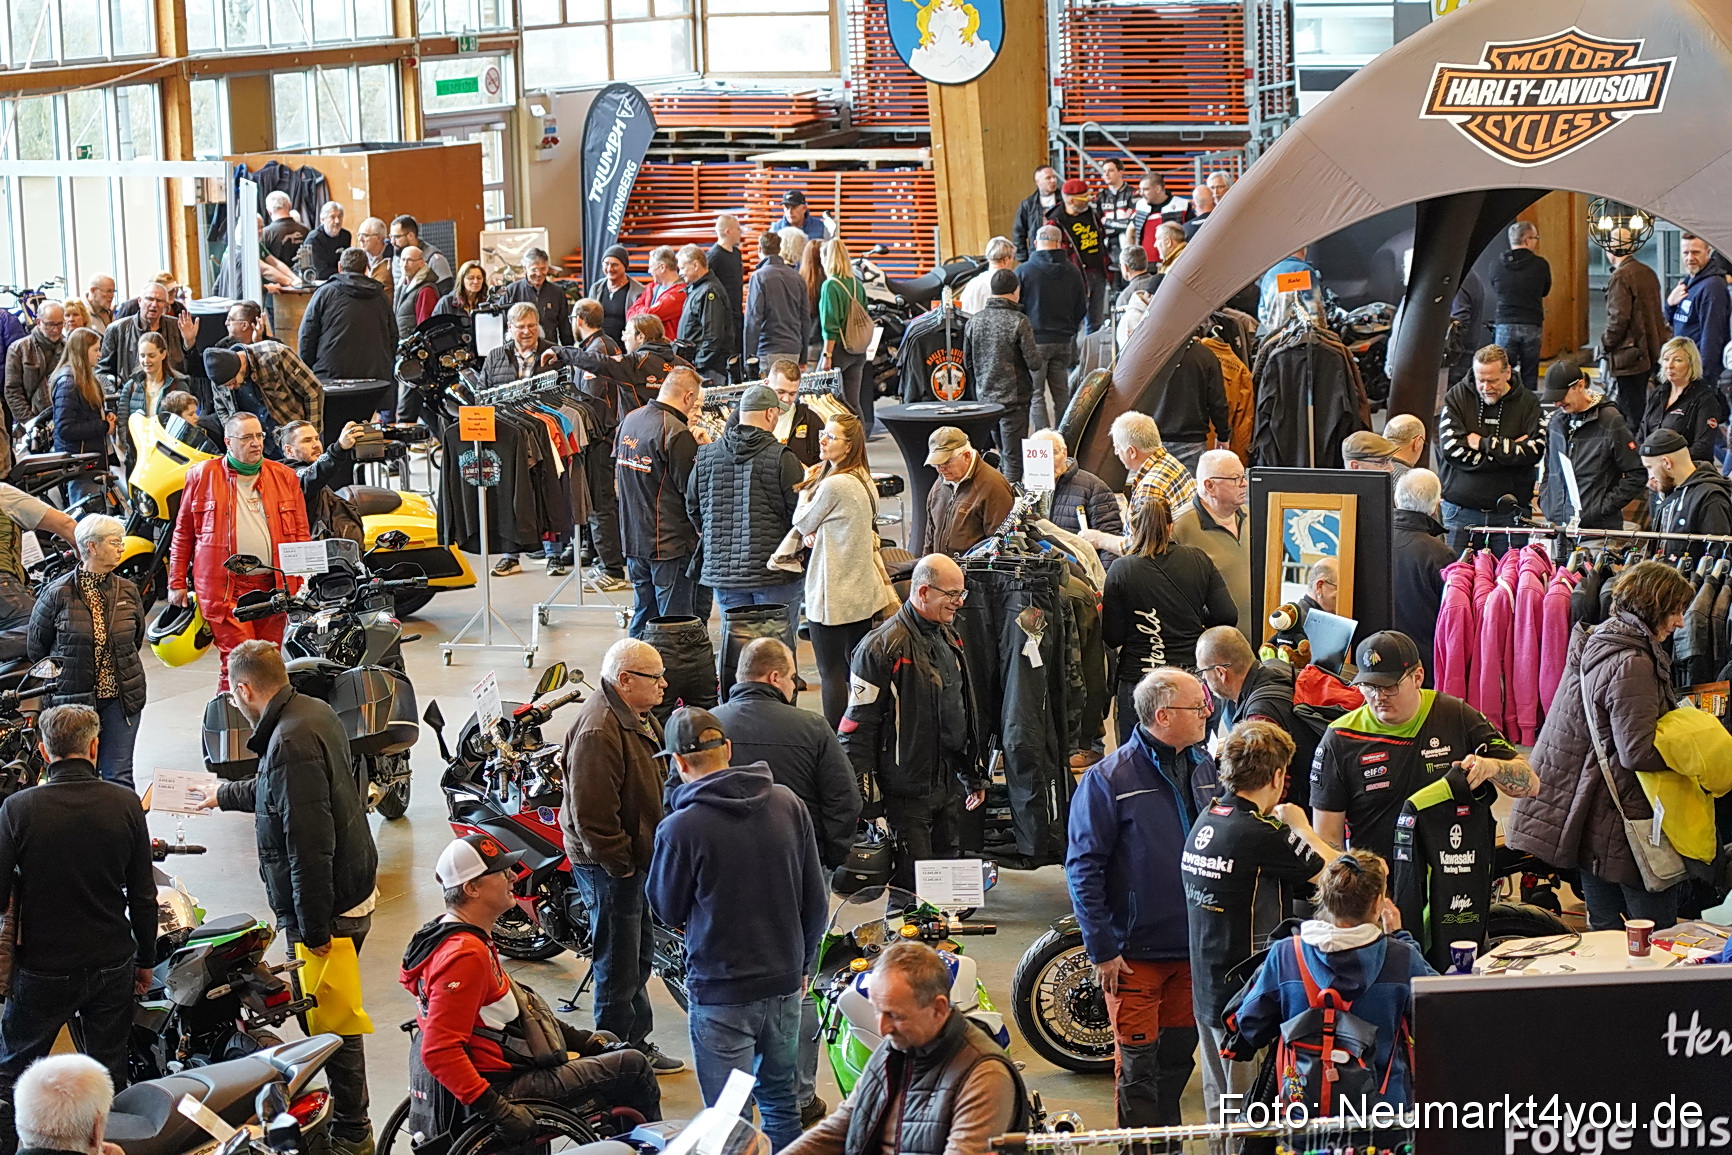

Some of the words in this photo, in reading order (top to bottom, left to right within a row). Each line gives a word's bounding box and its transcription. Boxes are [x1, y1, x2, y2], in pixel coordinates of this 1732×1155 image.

[1505, 42, 1615, 71] MOTOR
[1444, 73, 1653, 106] HARLEY-DAVIDSON
[1485, 114, 1592, 153] CYCLES
[588, 118, 627, 203] TRIUMPH
[606, 159, 637, 235] NÜRNBERG
[1287, 278, 1302, 288] Sale
[622, 435, 640, 450] Staff
[1027, 449, 1038, 459] 20
[1039, 449, 1049, 459] %
[1364, 767, 1378, 777] elf
[1183, 851, 1235, 874] awasaki
[1439, 850, 1476, 865] Kawasaki
[1198, 868, 1222, 880] Team
[1450, 894, 1474, 913] Ninja
[1505, 1112, 1635, 1155] Folge
[1650, 1116, 1732, 1148] uns
